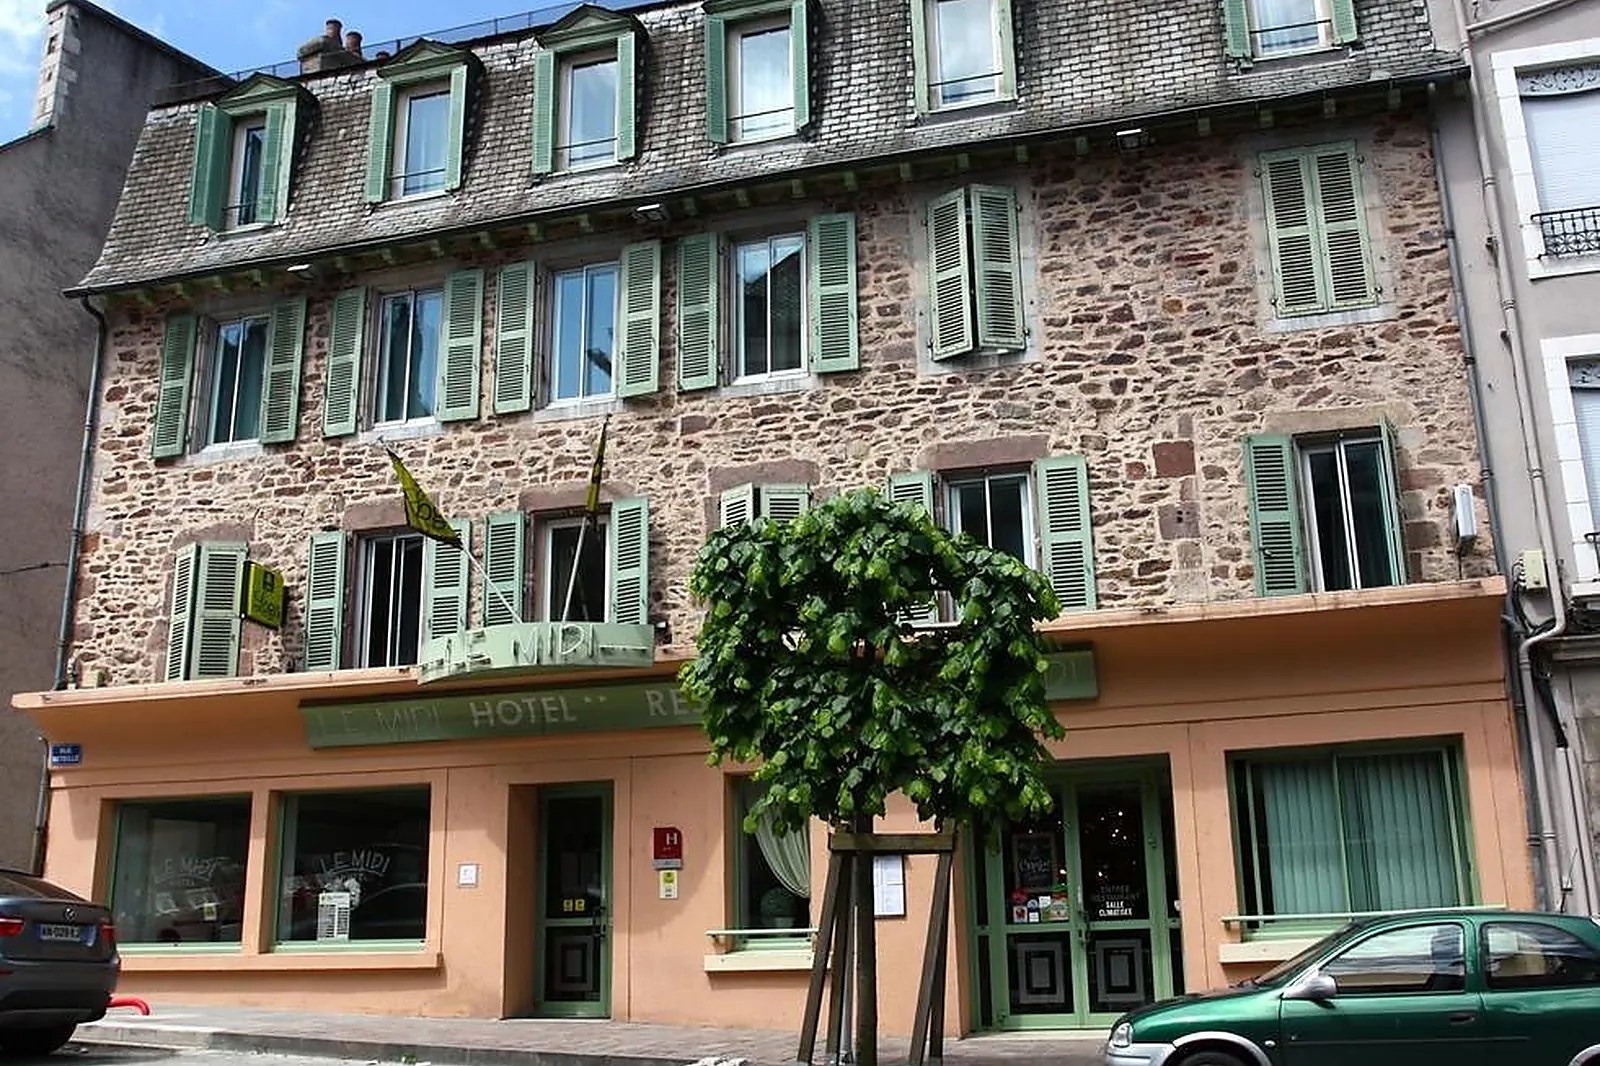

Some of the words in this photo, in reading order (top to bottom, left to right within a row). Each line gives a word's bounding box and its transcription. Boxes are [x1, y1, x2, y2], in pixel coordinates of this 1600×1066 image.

[511, 622, 598, 666] MIDI
[375, 703, 441, 733] MIDI
[469, 696, 578, 728] HOTEL
[666, 832, 678, 846] H
[319, 851, 346, 877] LE
[352, 848, 391, 874] MIDI
